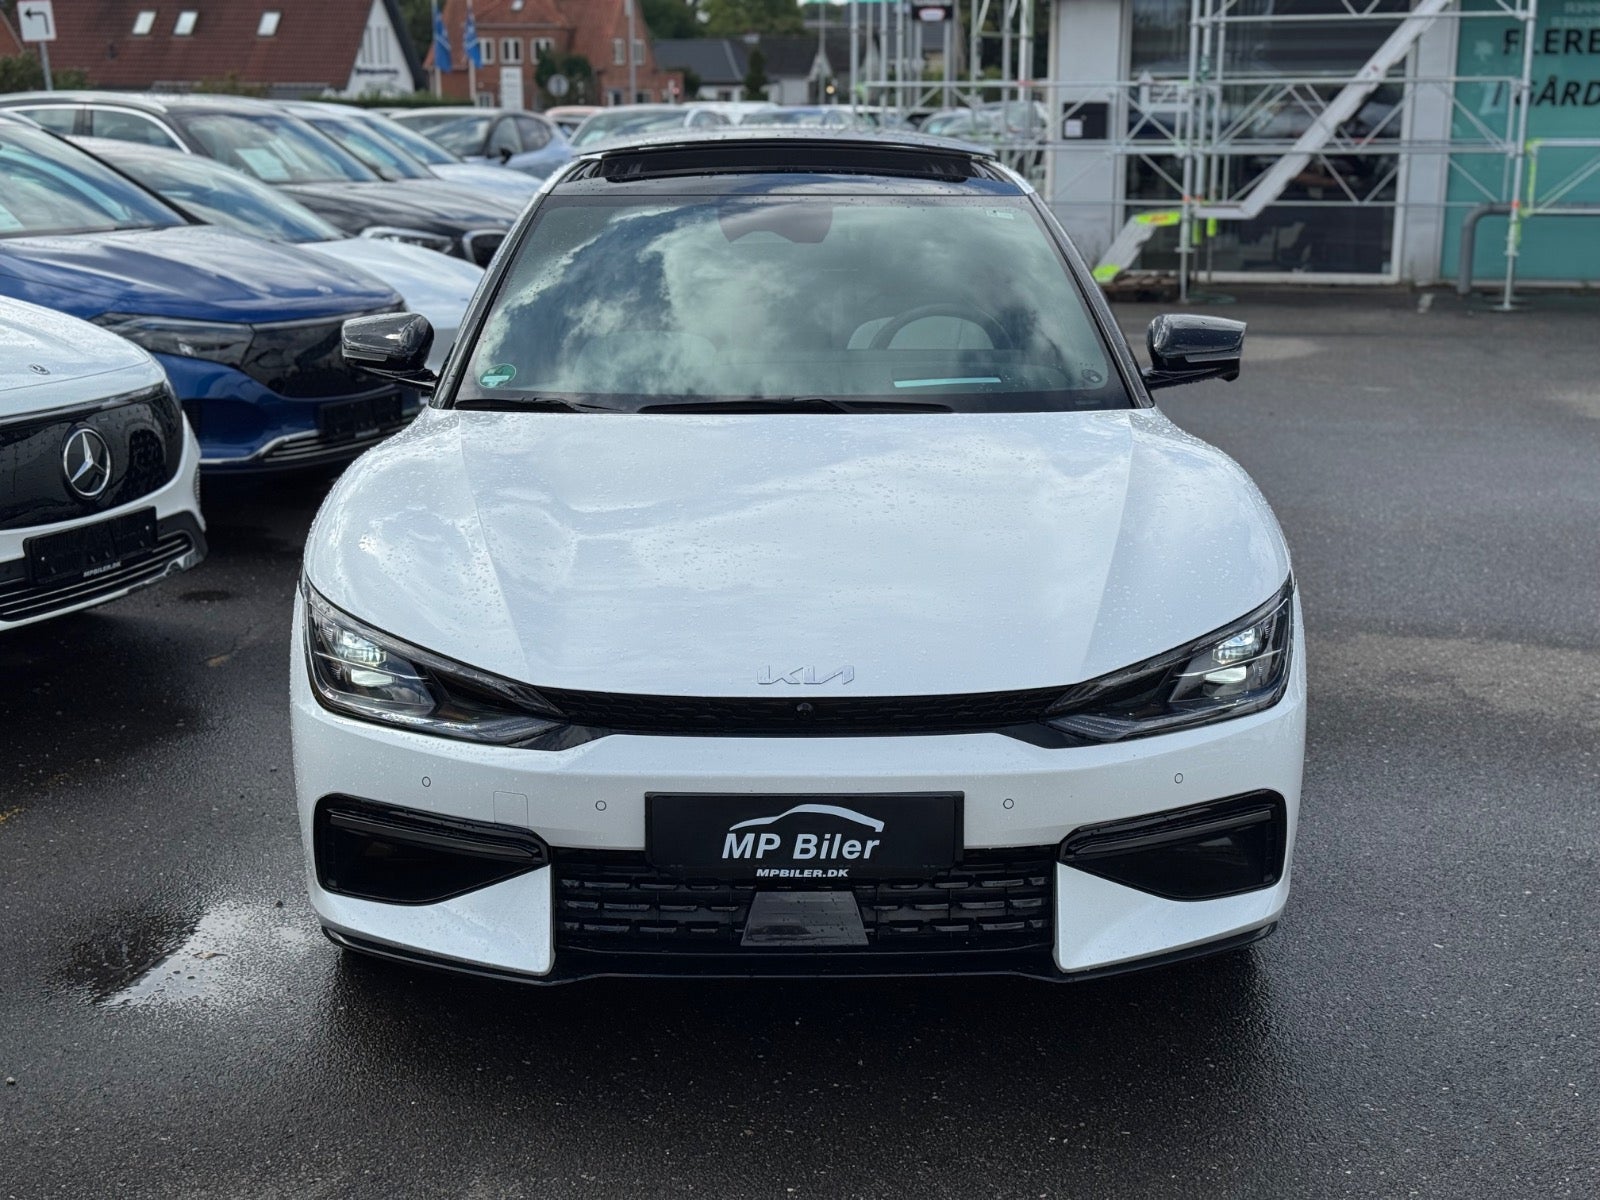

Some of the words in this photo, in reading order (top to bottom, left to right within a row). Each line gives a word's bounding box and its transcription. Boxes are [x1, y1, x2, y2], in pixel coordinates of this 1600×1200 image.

[1504, 29, 1600, 53] FERE
[757, 665, 855, 685] KIA
[722, 833, 781, 859] MP
[793, 833, 880, 860] Biler
[756, 868, 849, 878] MPBILER.DK
